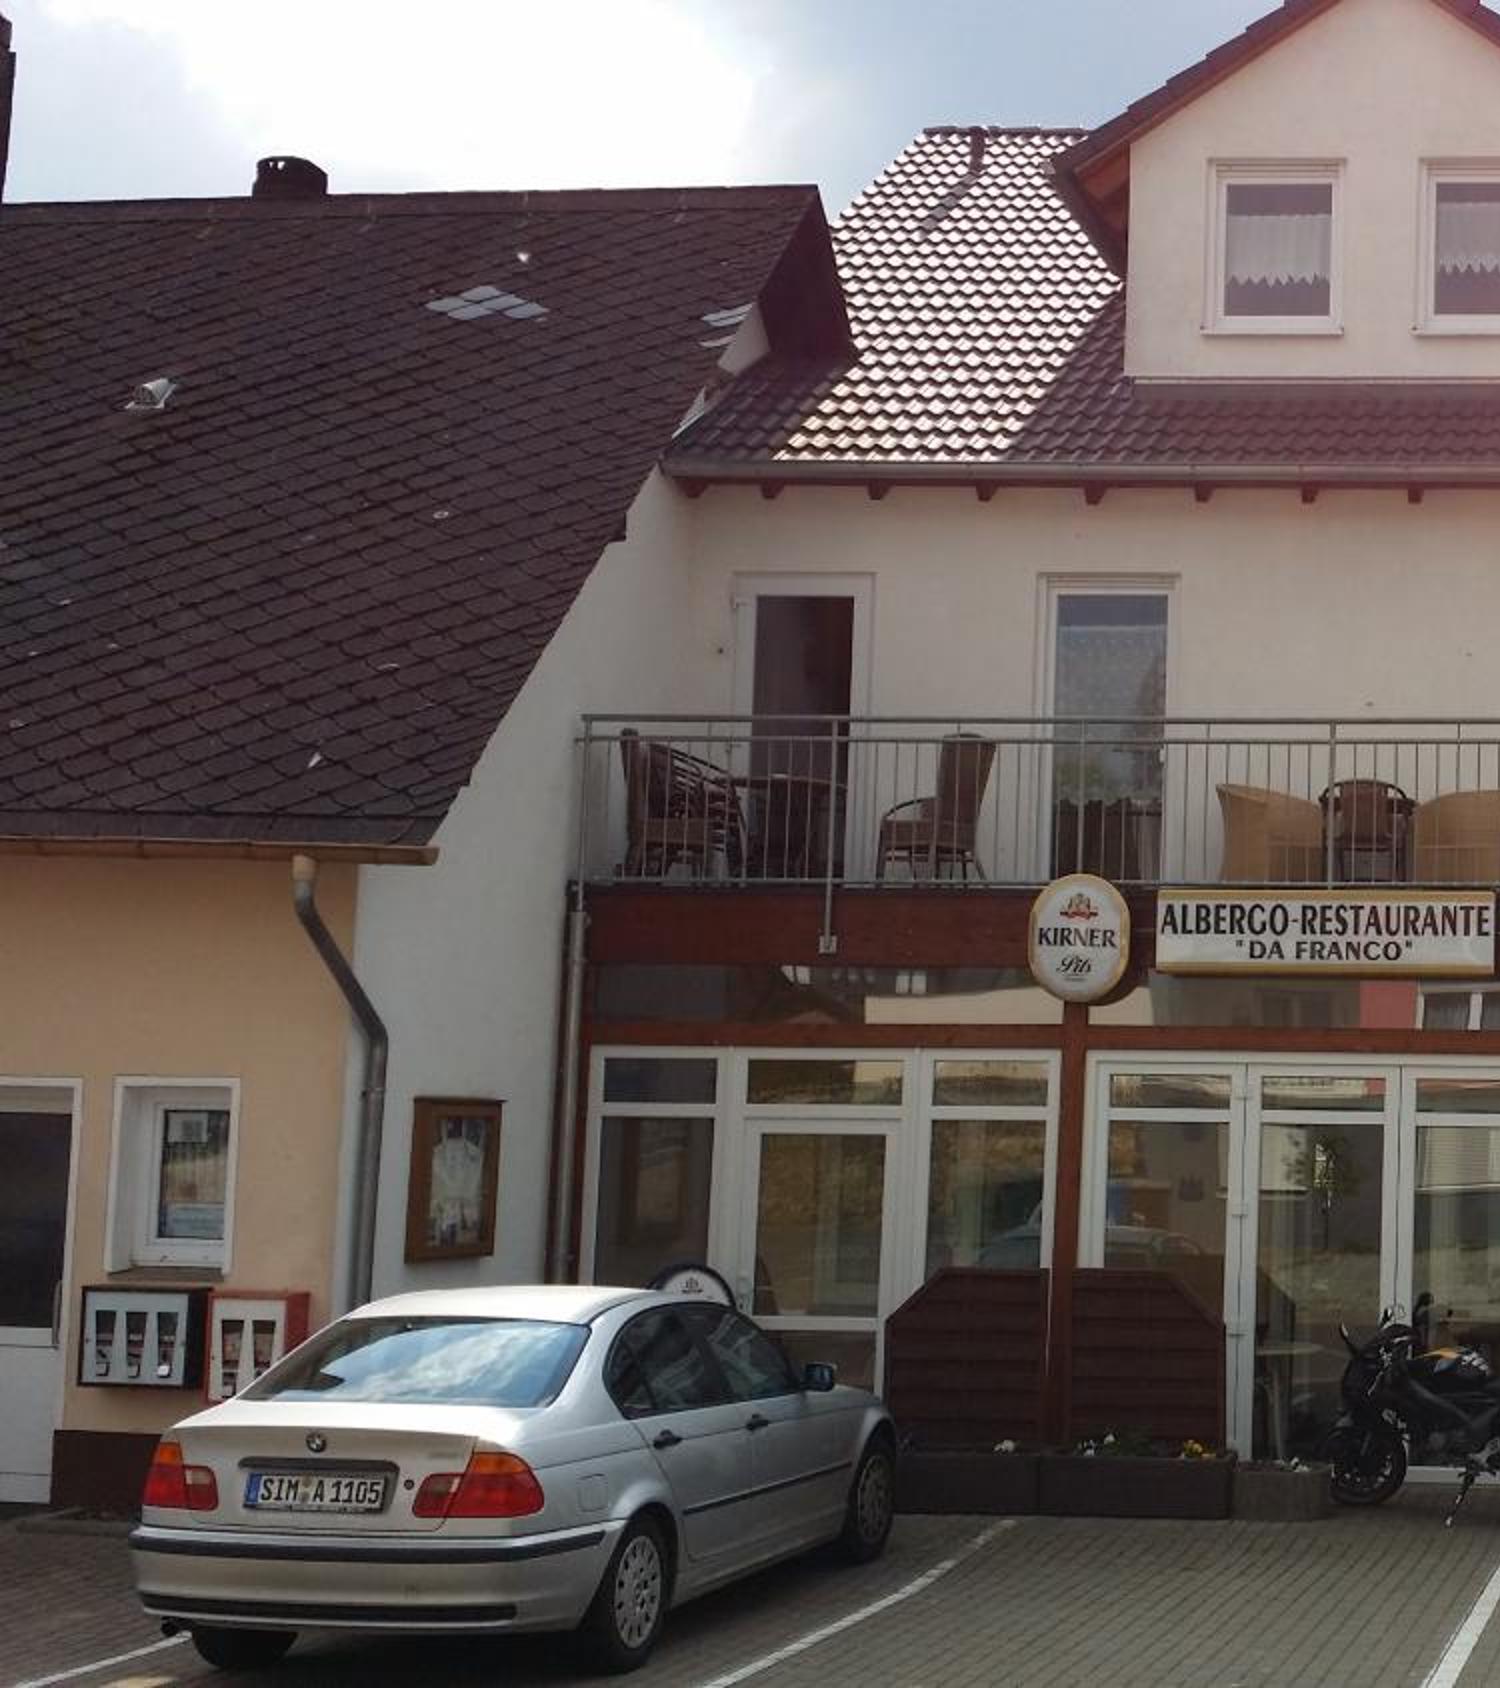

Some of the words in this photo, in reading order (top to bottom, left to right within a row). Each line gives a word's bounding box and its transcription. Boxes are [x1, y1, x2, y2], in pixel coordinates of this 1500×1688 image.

[1161, 903, 1490, 937] ALBERGO-RESTAURANTE
[1038, 926, 1117, 949] KIRNER
[1235, 939, 1285, 960] "DA
[1295, 940, 1413, 961] FRANCO"
[1056, 955, 1092, 974] Pils
[261, 1478, 300, 1502] SIM
[313, 1479, 326, 1503] A
[330, 1480, 382, 1505] 1105
